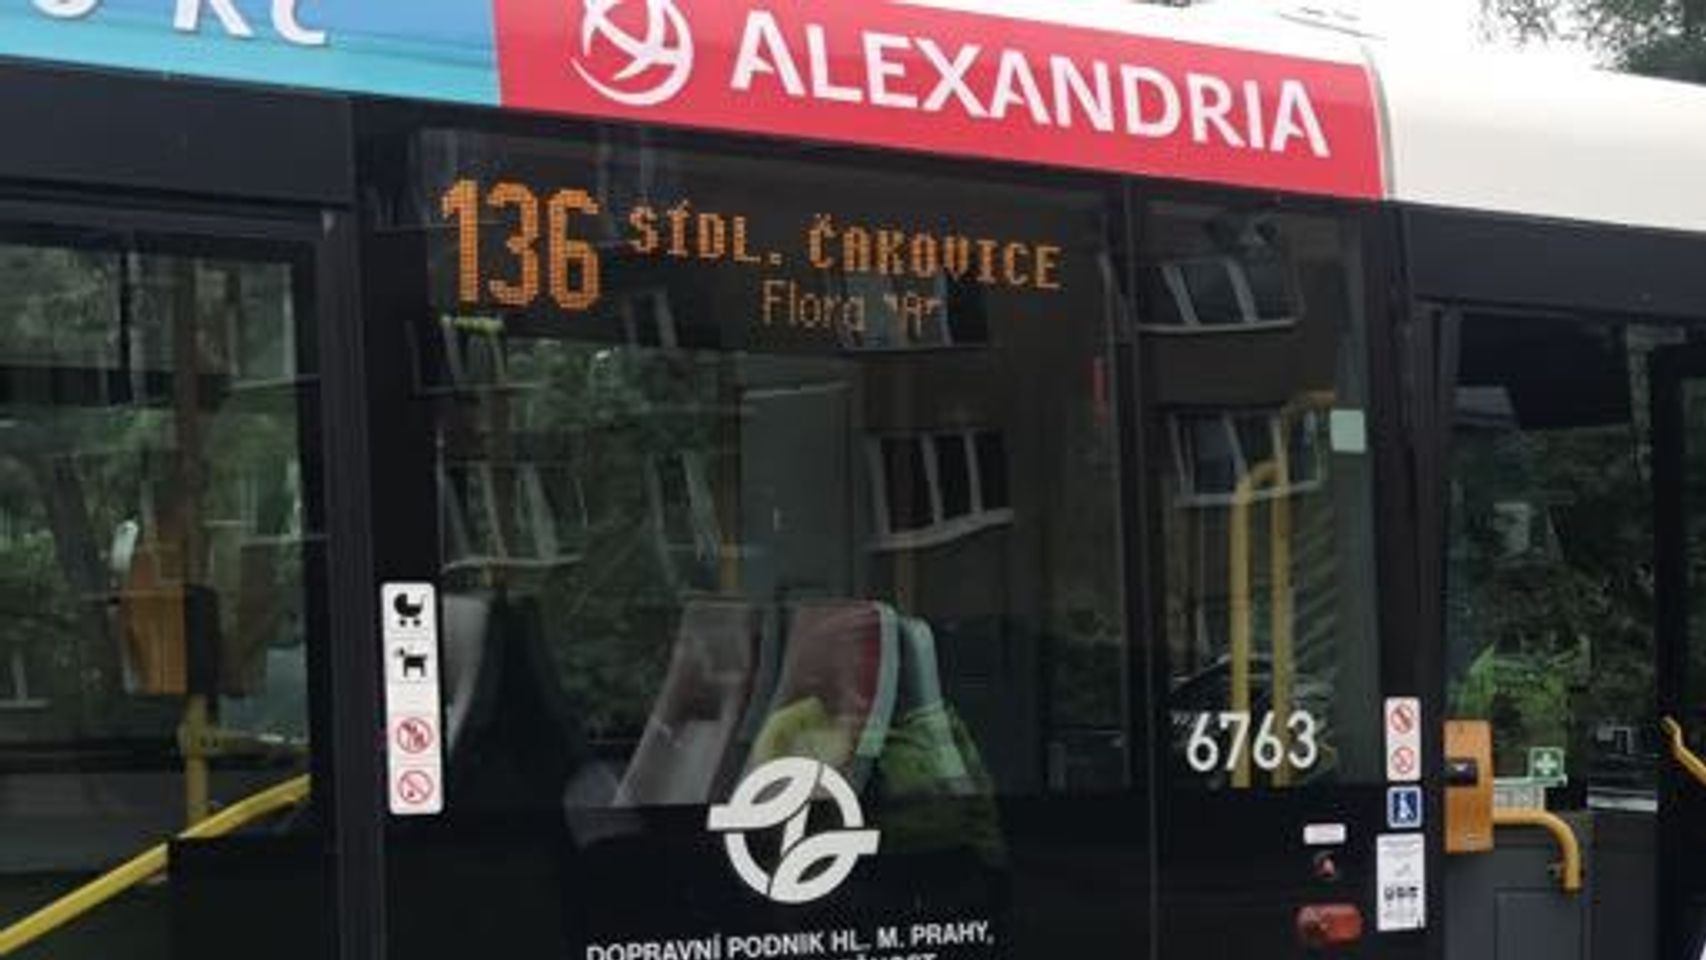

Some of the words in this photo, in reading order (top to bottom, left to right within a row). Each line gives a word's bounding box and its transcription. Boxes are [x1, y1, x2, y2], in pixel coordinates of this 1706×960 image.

[731, 9, 1330, 158] ALEXANDRIA
[440, 178, 600, 311] 136
[628, 201, 784, 266] SÍDL.
[807, 212, 1062, 290] ČAKOVICE
[762, 279, 866, 332] Flora
[1186, 709, 1318, 772] 6763
[727, 932, 824, 959] PODNIK
[831, 929, 871, 951] HL.
[877, 926, 904, 949] M.
